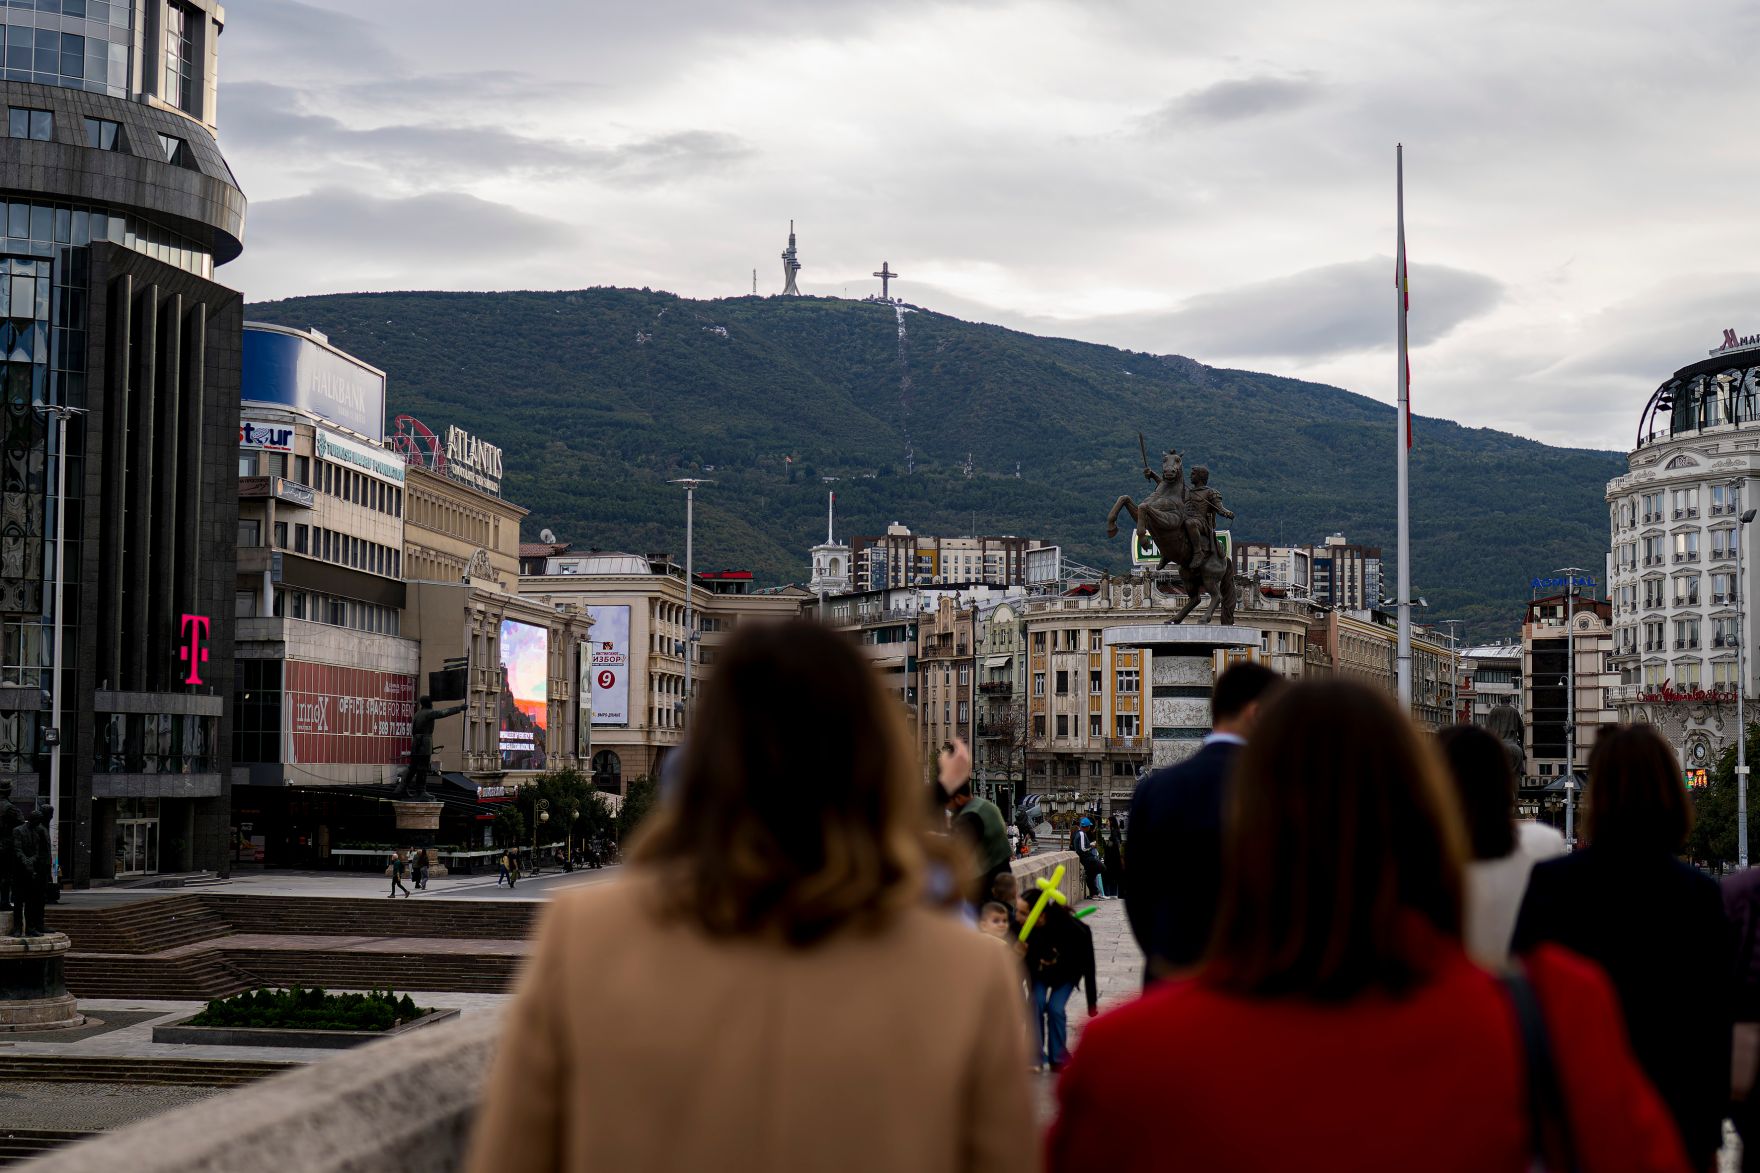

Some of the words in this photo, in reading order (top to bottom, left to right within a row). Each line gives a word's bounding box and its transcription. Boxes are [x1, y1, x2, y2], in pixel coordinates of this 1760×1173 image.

[312, 369, 366, 413] HALKBANK
[327, 441, 352, 462] TURKISH
[446, 424, 503, 479] ATLANTIS
[602, 673, 612, 687] 9
[339, 698, 364, 714] OFFICE
[366, 699, 386, 716] SPACE
[387, 702, 399, 717] FOR
